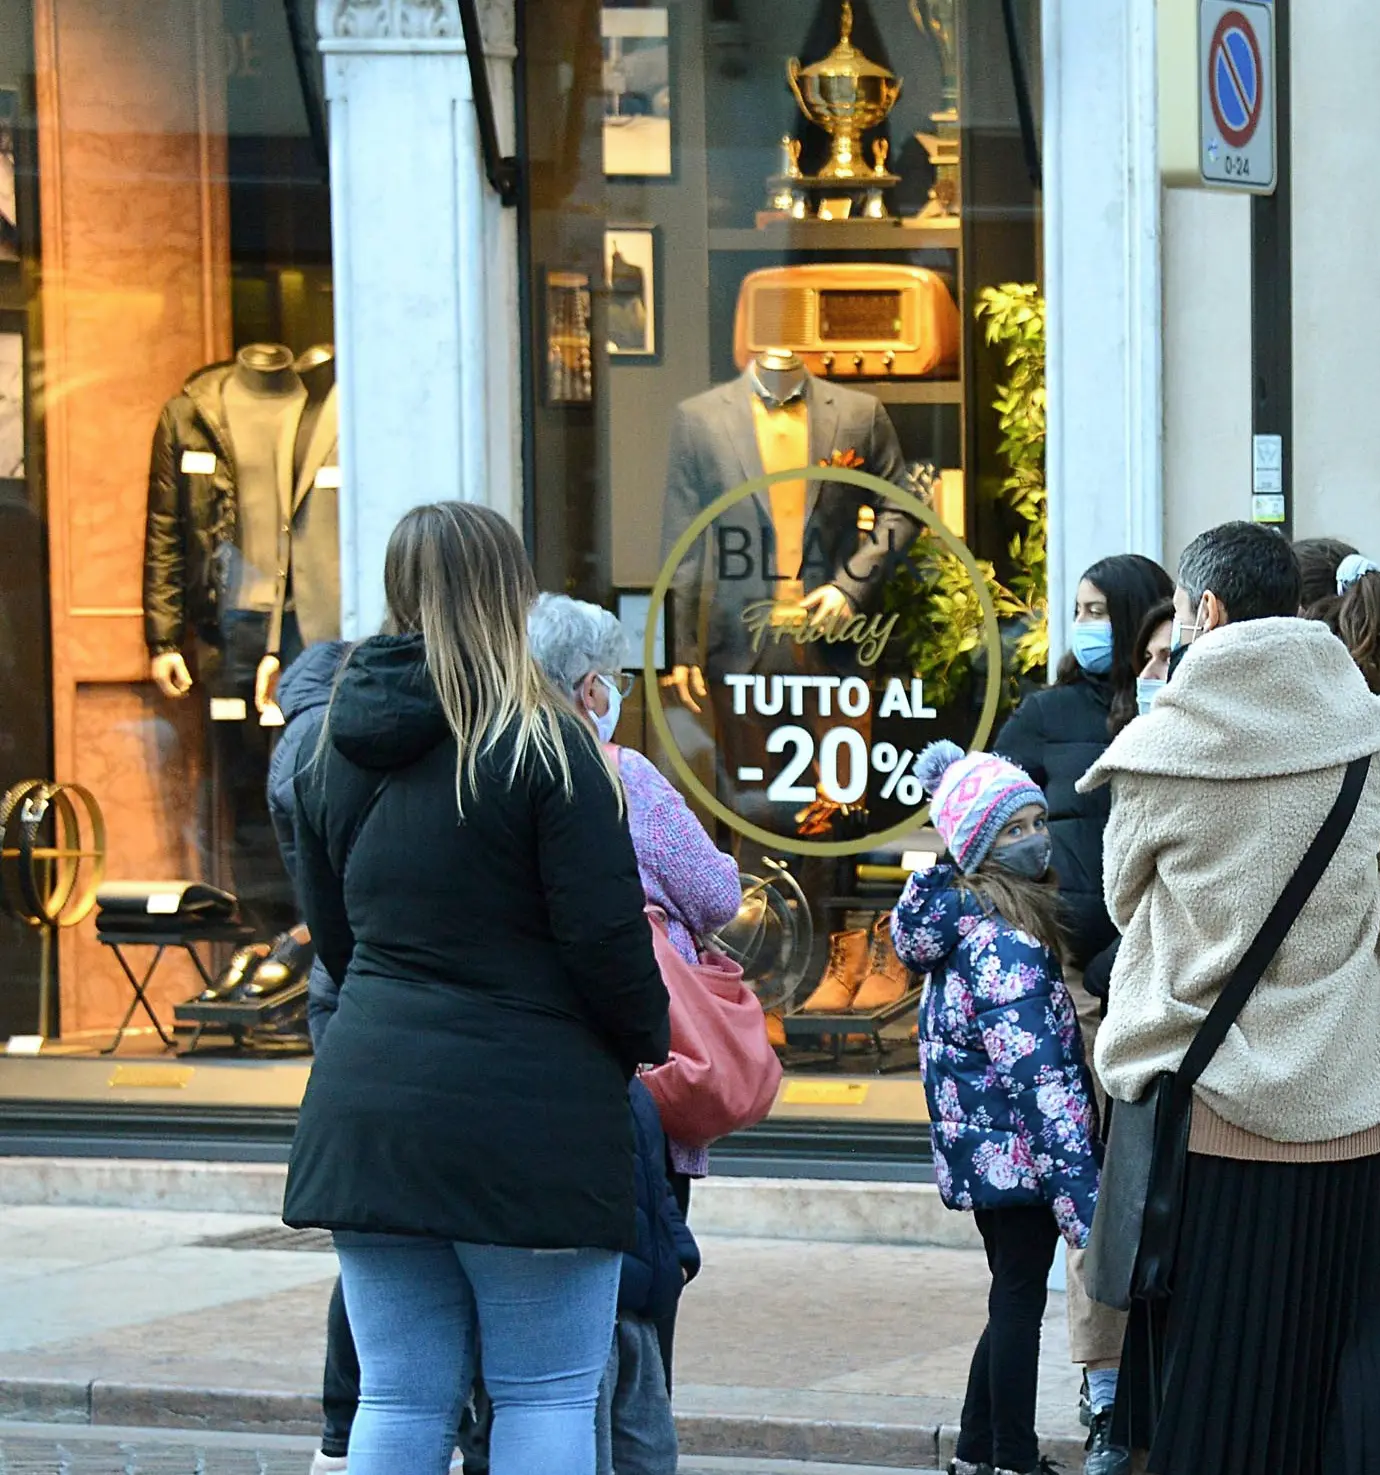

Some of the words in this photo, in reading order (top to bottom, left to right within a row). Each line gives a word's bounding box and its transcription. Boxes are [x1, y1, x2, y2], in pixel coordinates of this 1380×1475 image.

[1224, 156, 1250, 175] 0-24
[718, 525, 924, 582] BLACK
[741, 601, 900, 666] Friday
[725, 674, 871, 718] TUTTO
[878, 678, 936, 718] AL
[737, 725, 924, 805] -20%
